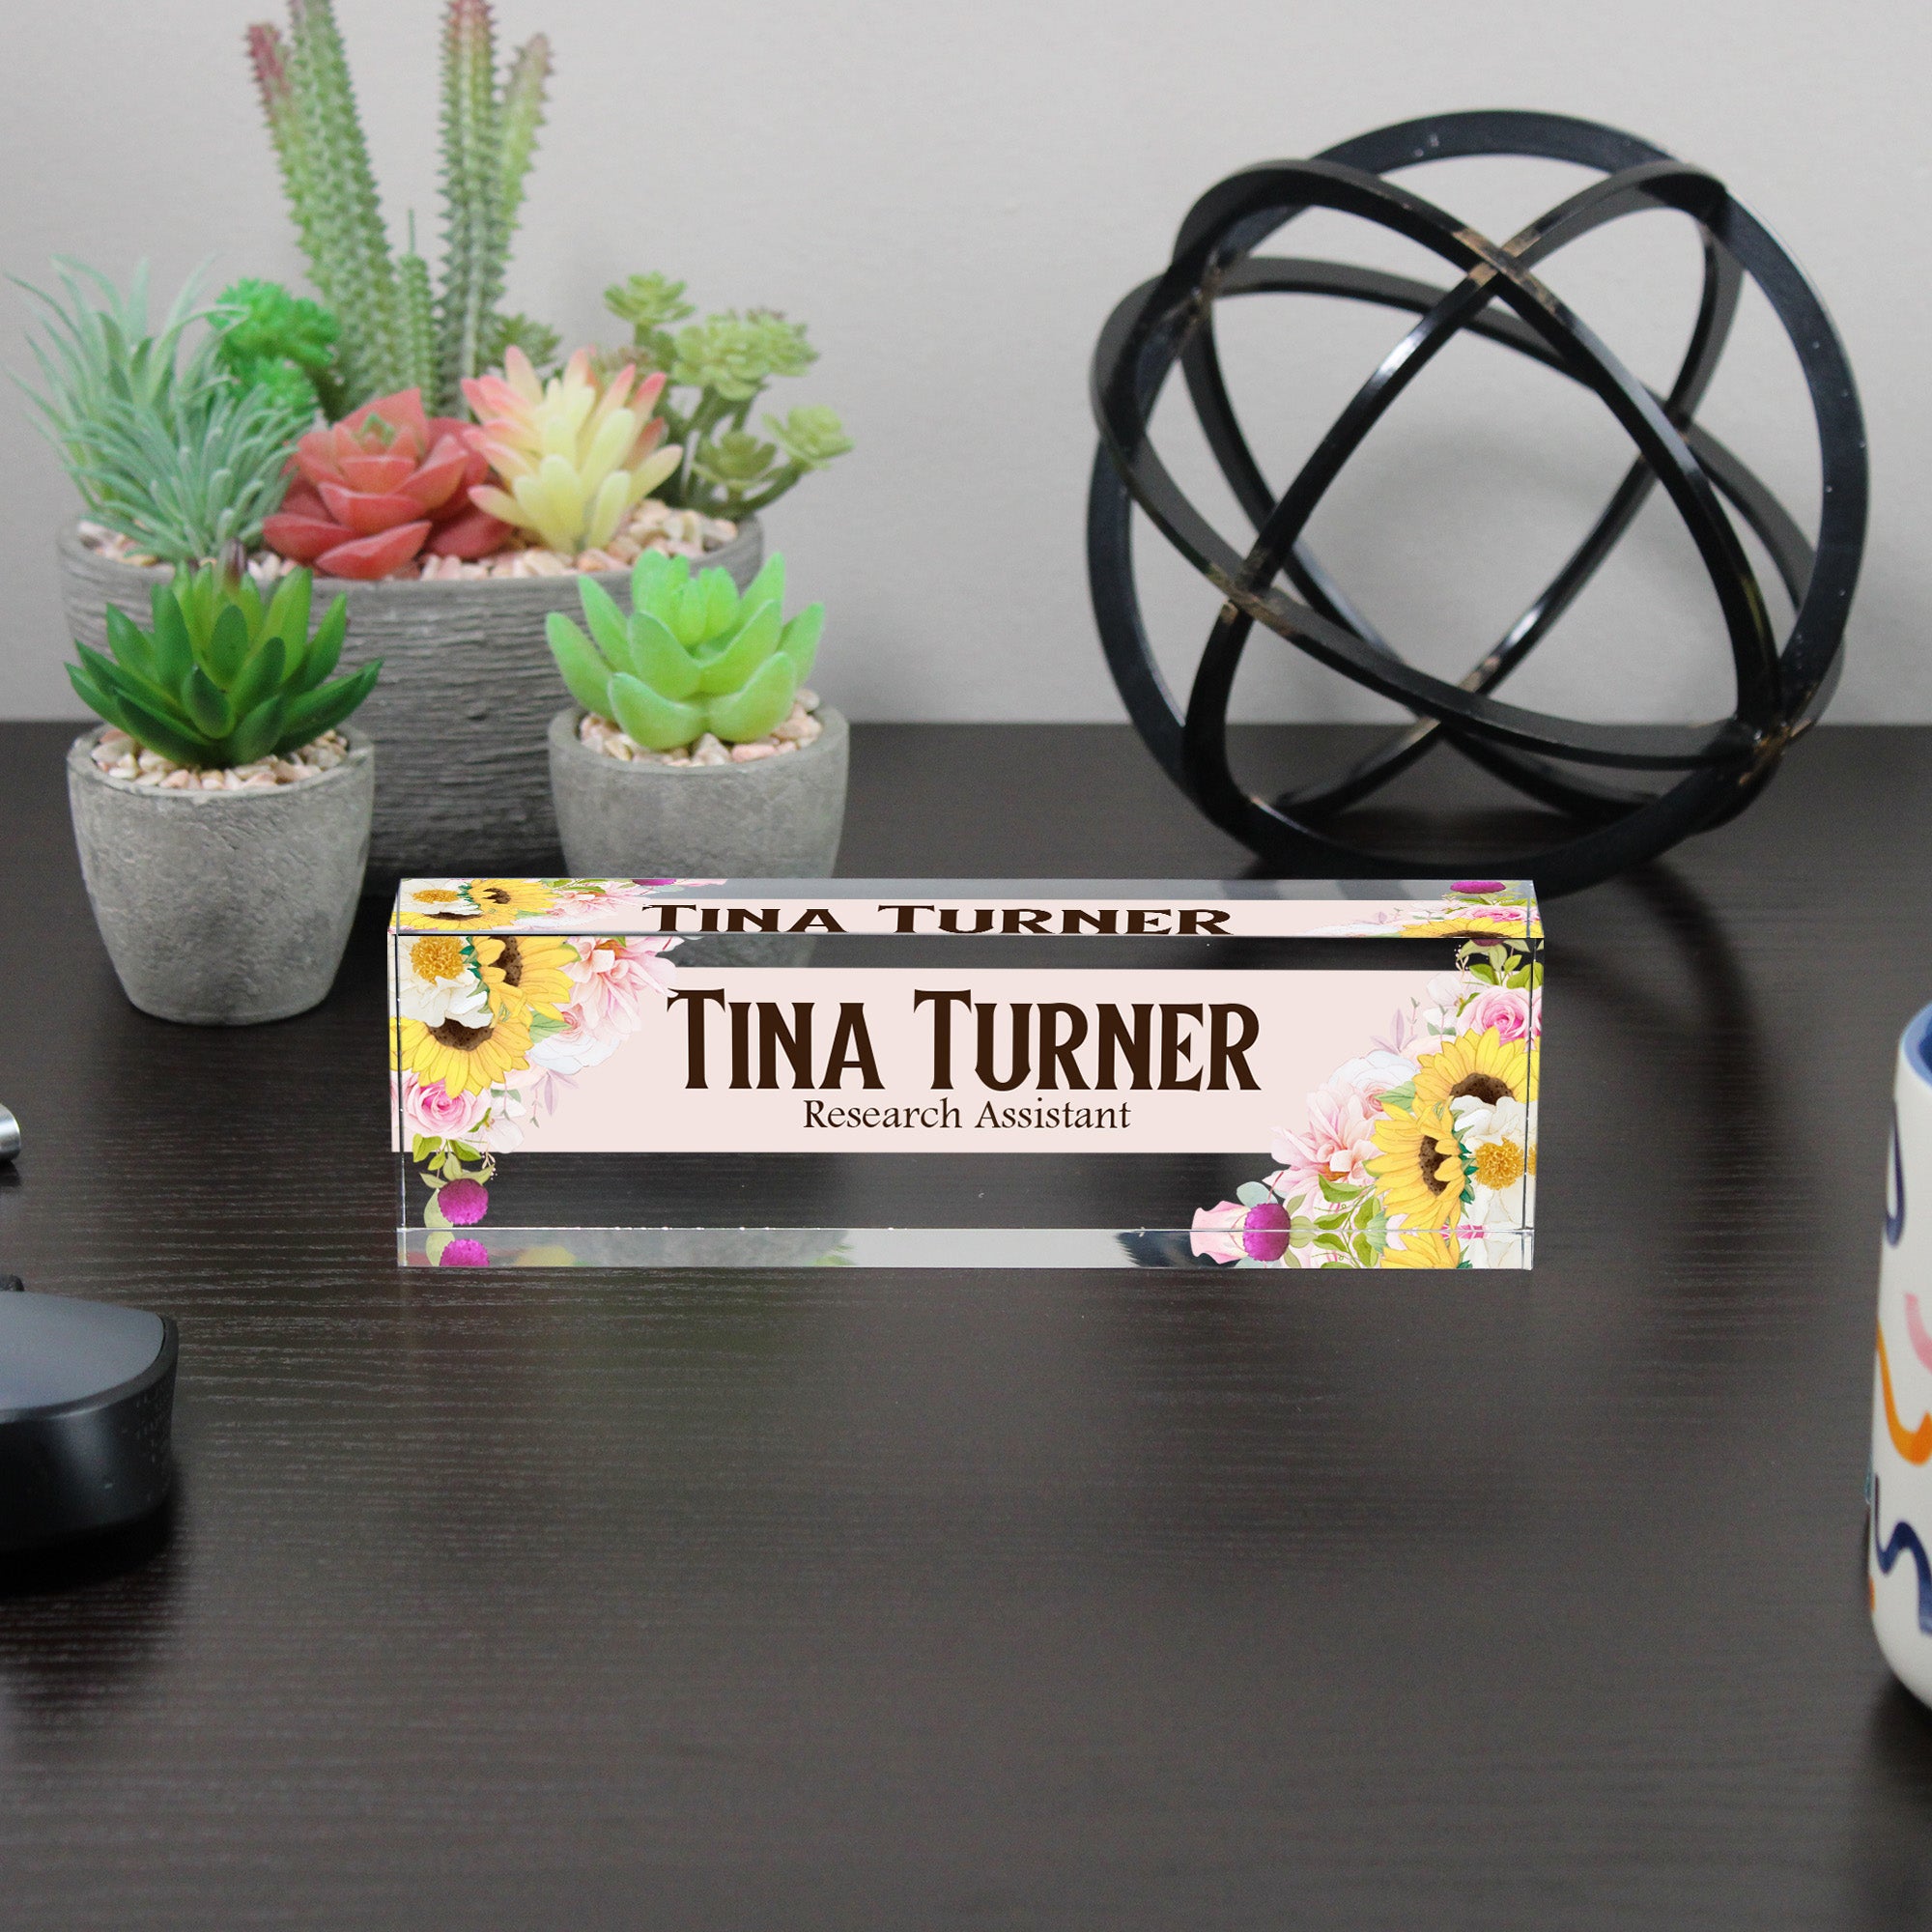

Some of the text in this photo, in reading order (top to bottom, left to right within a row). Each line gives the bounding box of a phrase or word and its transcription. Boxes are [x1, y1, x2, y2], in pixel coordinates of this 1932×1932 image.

[642, 904, 1232, 935] TINA TURNER
[667, 987, 1262, 1093] TINA TURNER
[803, 1096, 1131, 1129] Research Assistant
